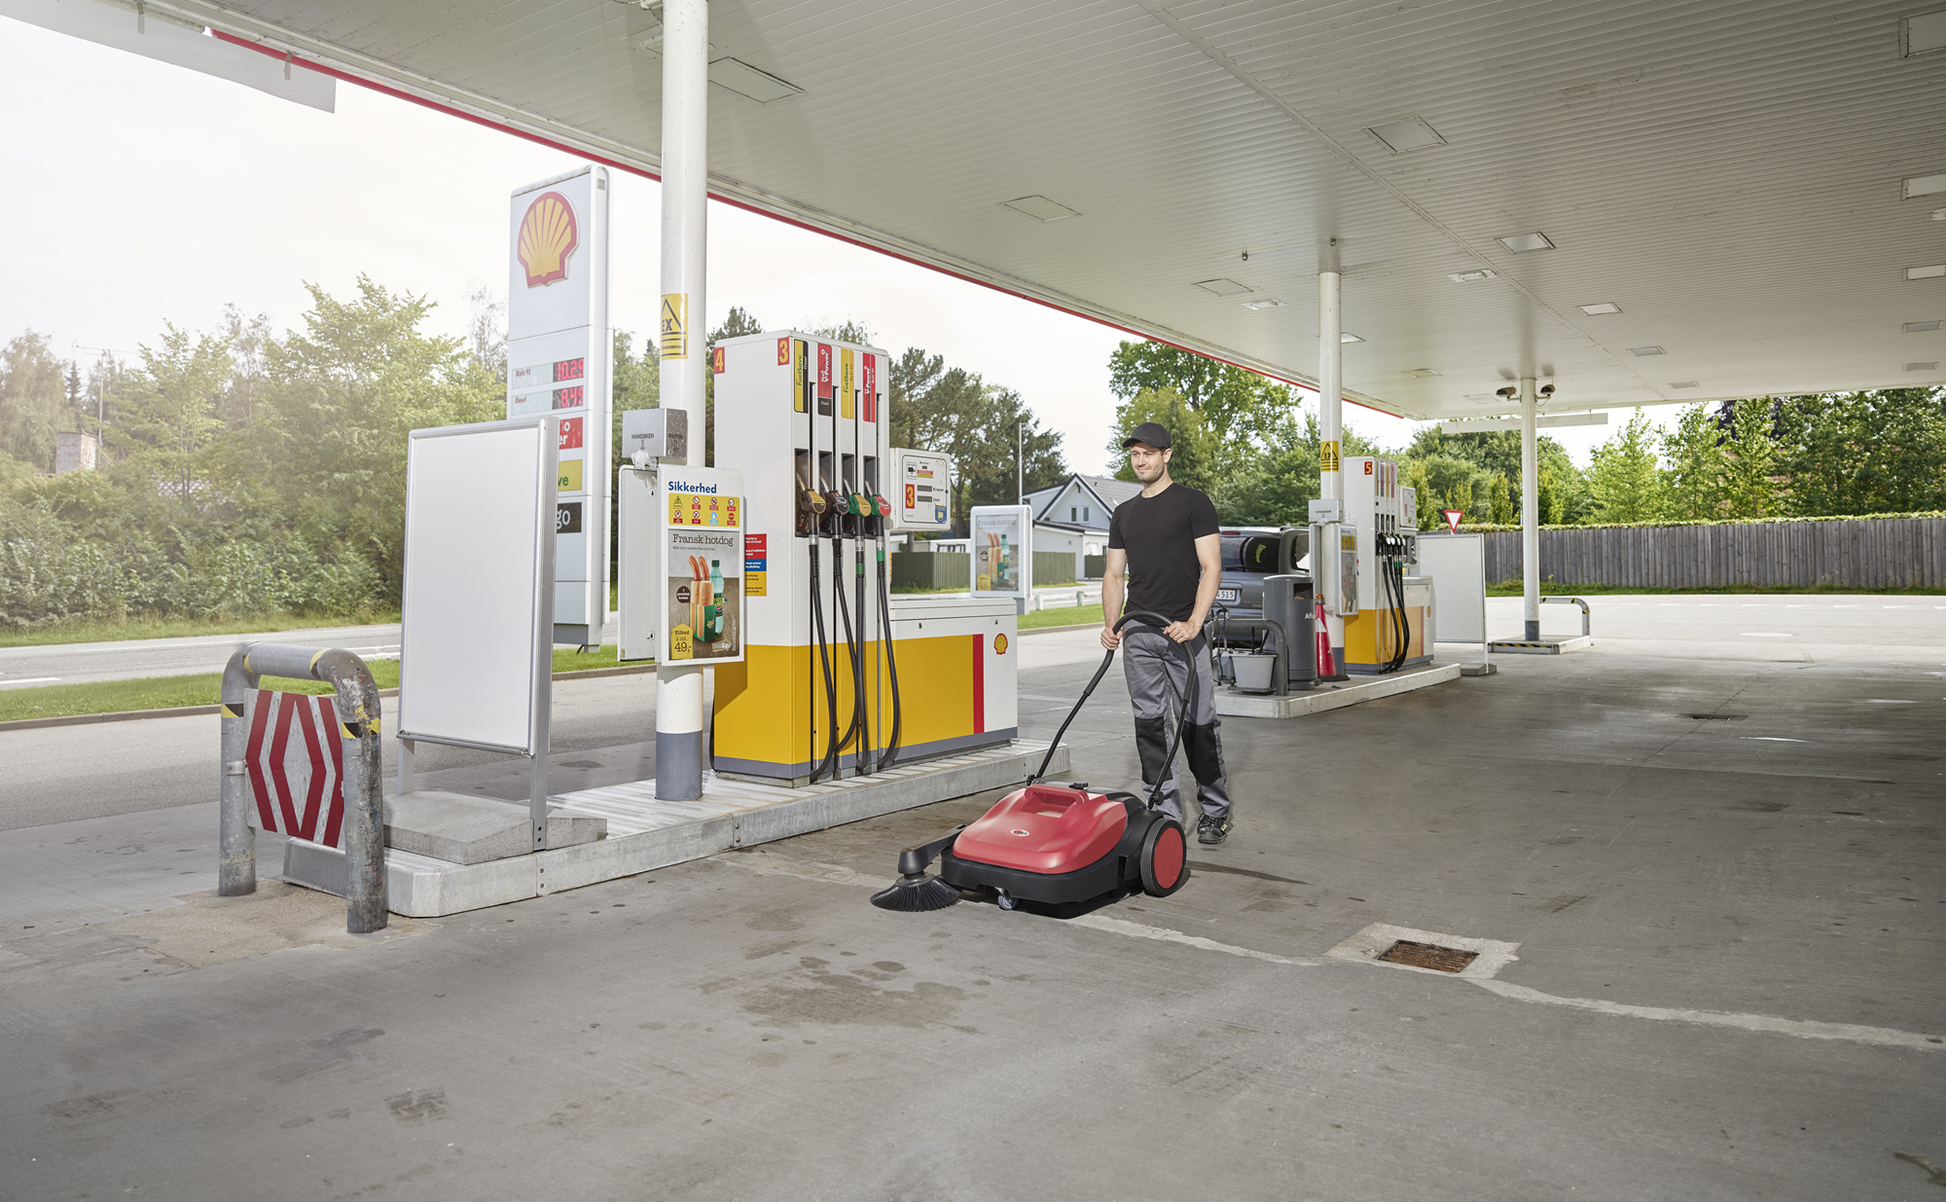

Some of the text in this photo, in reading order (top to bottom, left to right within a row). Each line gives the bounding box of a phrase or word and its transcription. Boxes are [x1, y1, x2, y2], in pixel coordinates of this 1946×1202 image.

[662, 318, 673, 332] EX
[715, 349, 724, 371] 4
[779, 340, 788, 363] 3
[557, 358, 584, 381] 10.29
[561, 386, 584, 408] 8.49
[1365, 462, 1372, 474] 5
[668, 481, 717, 494] Sikkerhed
[906, 486, 914, 507] 3
[672, 533, 704, 544] Fransk
[704, 535, 734, 548] hotdog
